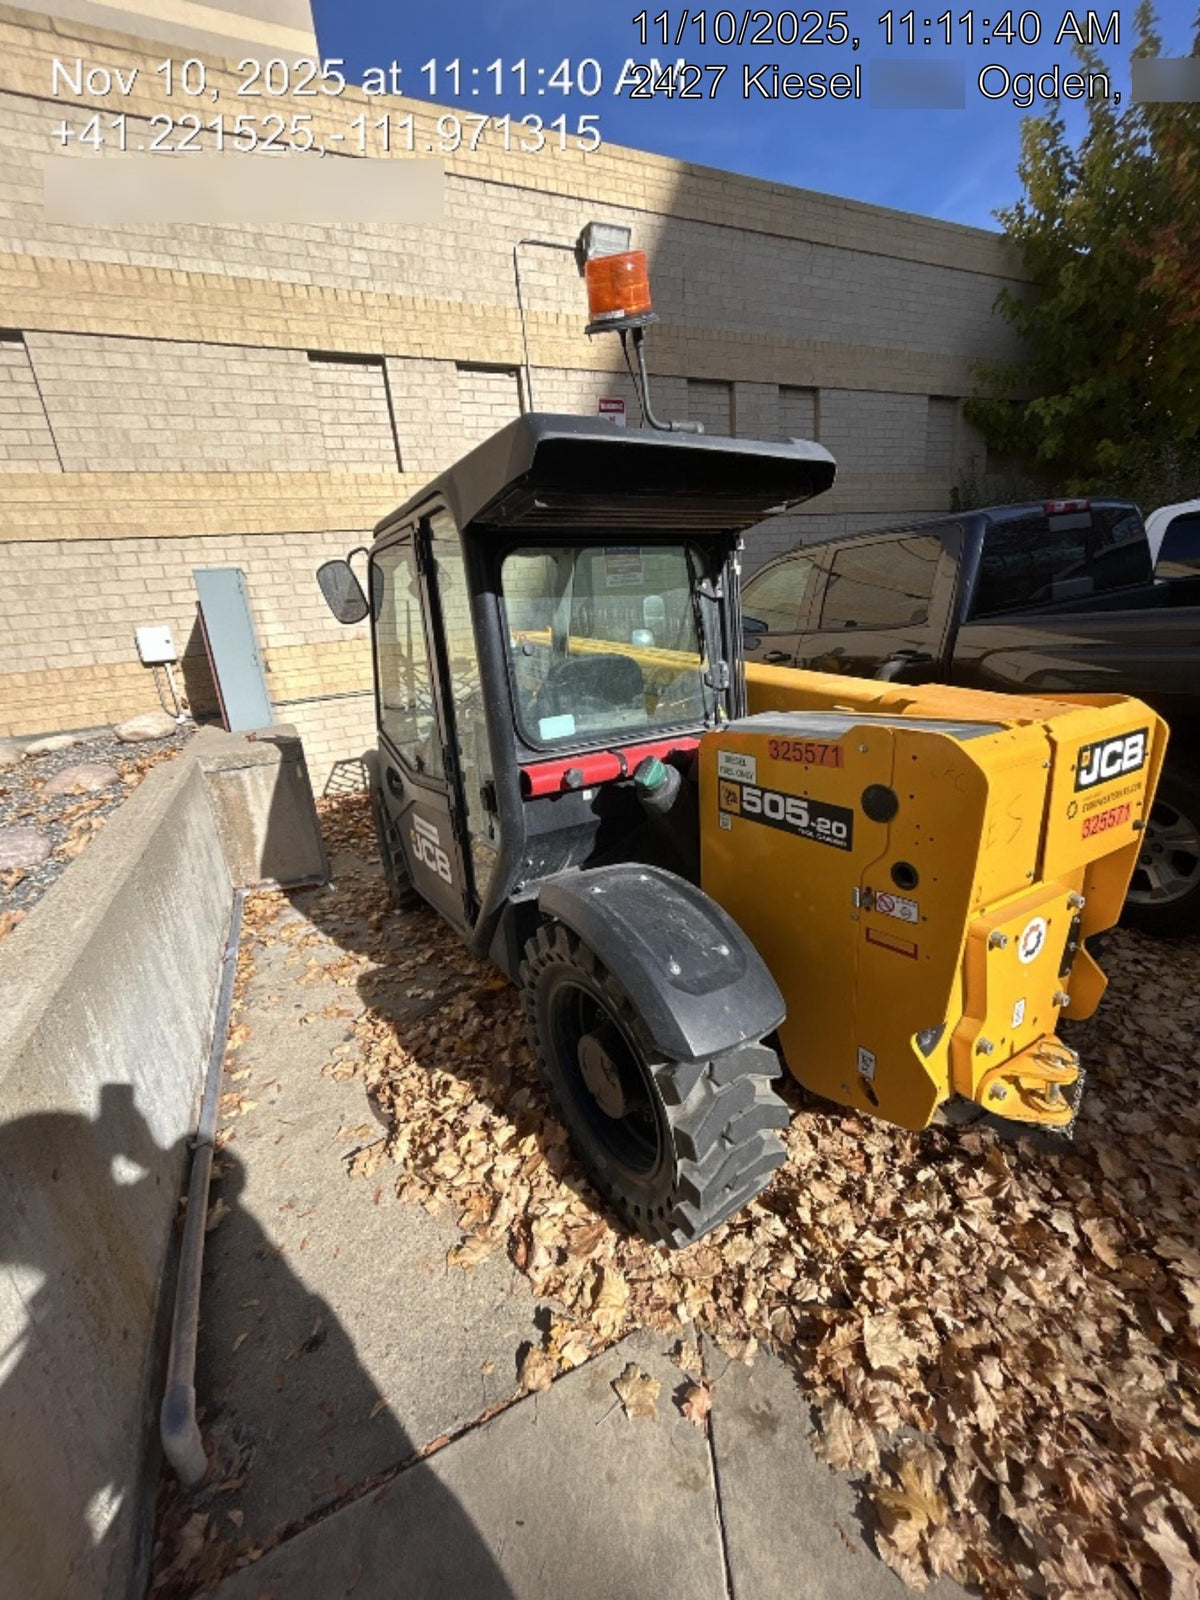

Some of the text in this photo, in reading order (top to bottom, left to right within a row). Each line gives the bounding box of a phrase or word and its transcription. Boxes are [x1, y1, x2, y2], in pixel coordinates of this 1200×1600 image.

[768, 739, 841, 767] 325571
[1079, 733, 1145, 785] JCB
[1081, 803, 1132, 839] 325571
[411, 832, 453, 885] JCB
